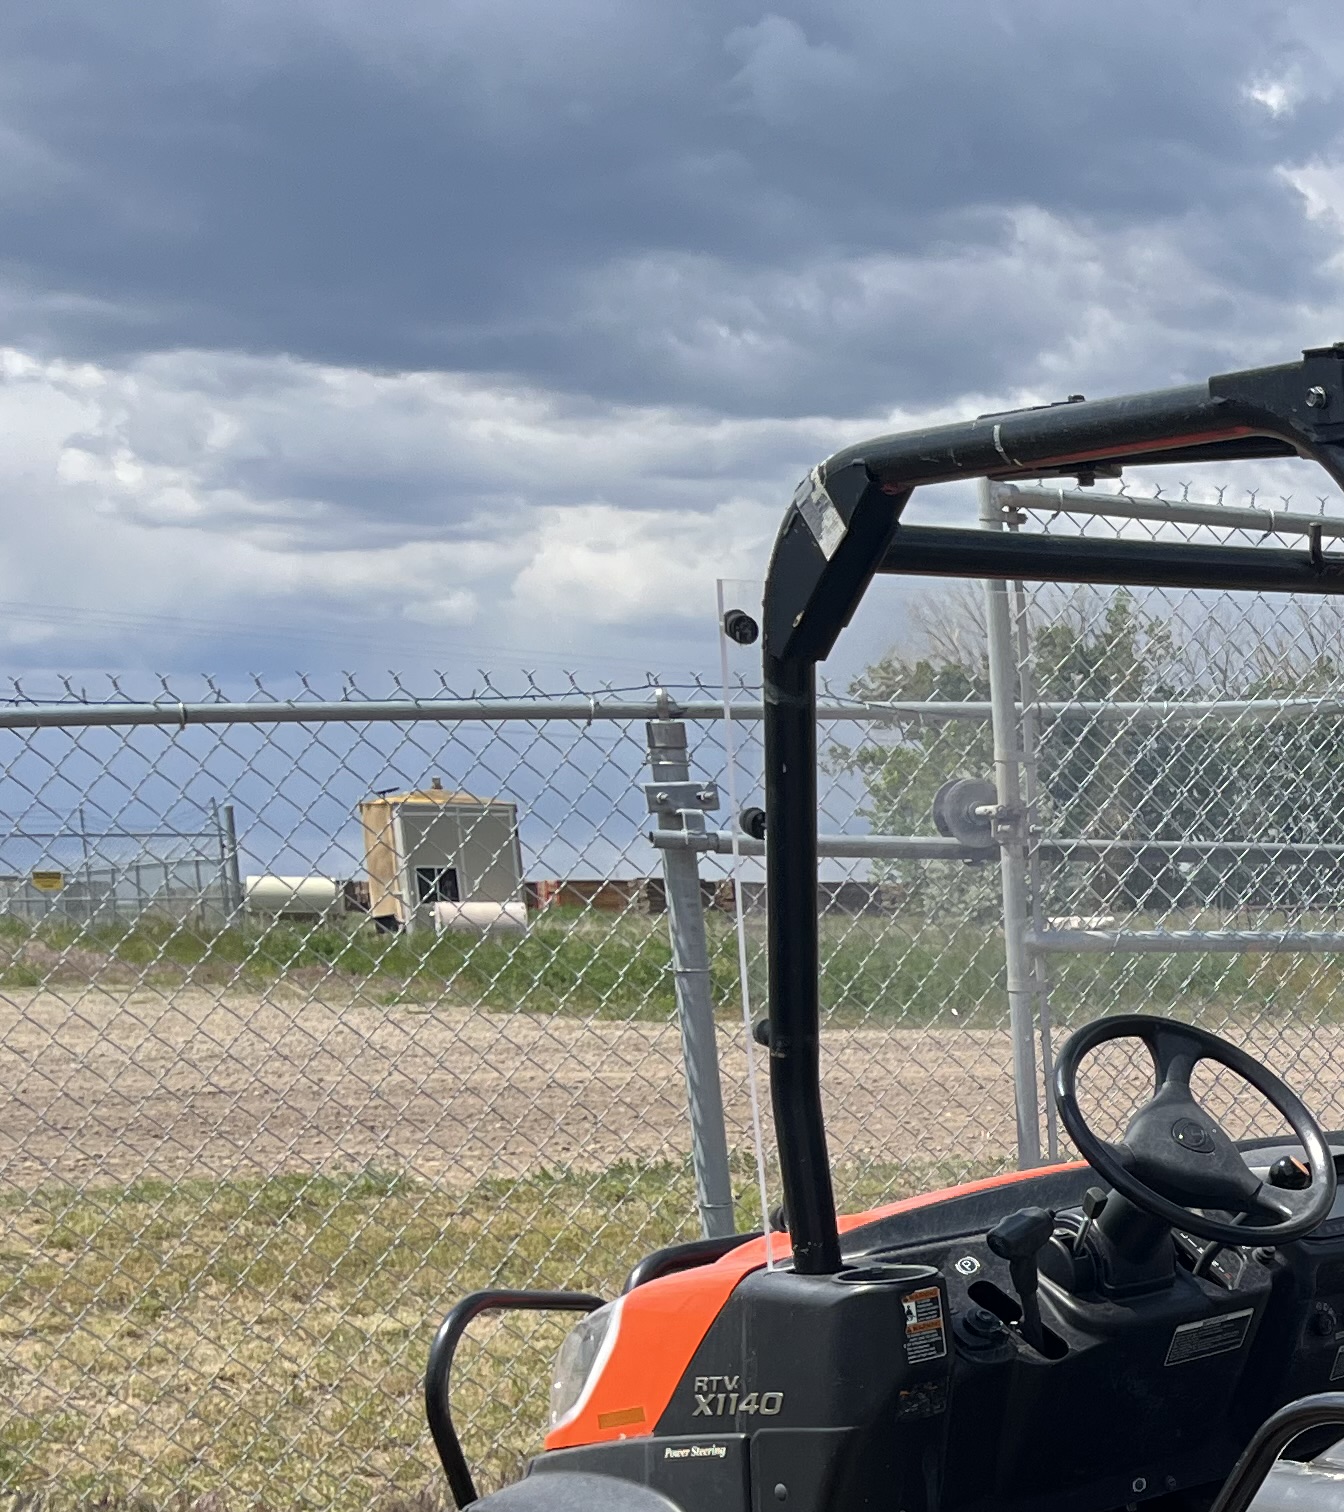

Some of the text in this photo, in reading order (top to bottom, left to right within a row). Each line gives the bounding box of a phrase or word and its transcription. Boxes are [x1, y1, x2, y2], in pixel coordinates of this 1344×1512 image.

[694, 1375, 740, 1392] RTV
[691, 1391, 784, 1417] X1140
[664, 1443, 727, 1459] Power Steering
